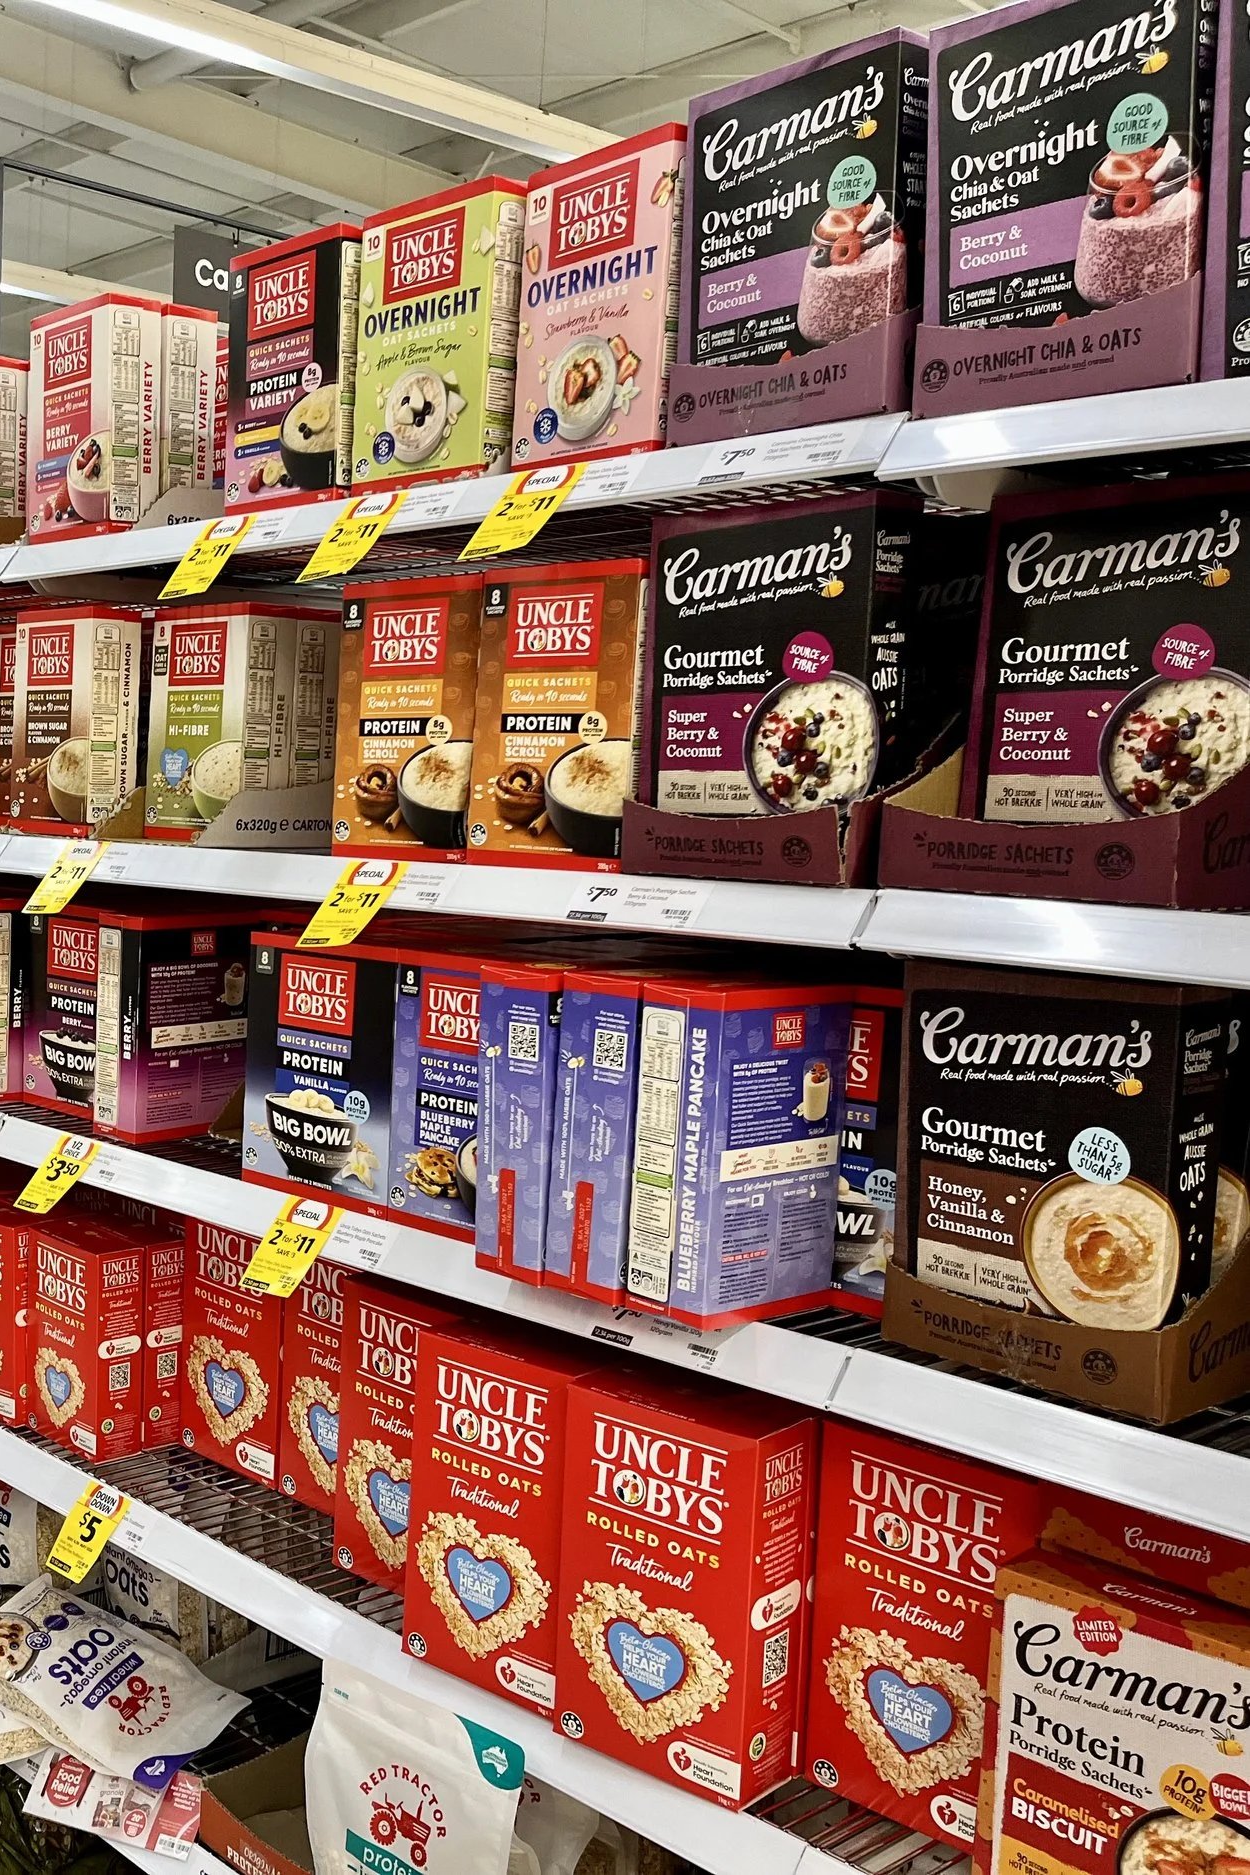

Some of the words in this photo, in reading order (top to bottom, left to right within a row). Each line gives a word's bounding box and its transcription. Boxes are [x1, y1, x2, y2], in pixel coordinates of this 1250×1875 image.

[949, 0, 1176, 122] Carman's
[970, 119, 993, 135] Real
[994, 107, 1015, 124] food
[1016, 96, 1042, 114] made
[1044, 87, 1064, 103] with
[1065, 76, 1085, 94] real
[1125, 102, 1152, 116] GOOD
[1113, 119, 1149, 133] SOURCE
[1121, 132, 1148, 146] FIBRE
[951, 119, 1098, 181] Overnight
[950, 182, 988, 203] Chia
[990, 175, 1005, 193] &
[1008, 166, 1040, 187] Oat
[950, 192, 1019, 222] Sachets
[391, 223, 456, 269] UNCLE
[390, 252, 456, 289] TOBYS
[527, 245, 658, 308] OVERNIGHT
[364, 287, 481, 339] OVERNIGHT
[547, 301, 569, 316] OAT
[573, 285, 629, 309] SACHETS
[250, 344, 272, 357] QUICK
[276, 335, 310, 351] SACHETS
[376, 350, 398, 370] Apple
[409, 342, 433, 358] Brown
[435, 341, 462, 359] Sugar
[953, 351, 1036, 377] OVERNIGHT
[1040, 342, 1075, 362] CHIA
[1080, 338, 1093, 354] &
[1098, 328, 1141, 349] OATS
[144, 361, 154, 421] VARIETY
[250, 372, 297, 395] PROTEIN
[250, 389, 296, 410] VARIETY
[143, 426, 152, 474] BERRY
[527, 475, 560, 487] SPECIAL
[496, 502, 514, 517] 2
[529, 495, 557, 512] $11
[1007, 509, 1241, 594] Carman's
[516, 598, 593, 629] UNCLE
[515, 622, 591, 654] TOBYS
[1002, 637, 1130, 664] Gourmet
[789, 644, 820, 662] SOURCE
[792, 657, 818, 674] FIBRE
[999, 668, 1065, 685] Porridge
[1069, 665, 1130, 681] Sachets
[168, 723, 210, 737] HI-FIBRE
[506, 716, 571, 730] PROTEIN
[1004, 708, 1054, 725] Super
[504, 736, 565, 746] CINNAMON
[1002, 728, 1051, 744] Berry
[1054, 728, 1068, 741] &
[505, 747, 546, 757] SCROLL
[1000, 746, 1071, 760] Coconut
[1012, 799, 1042, 807] BREKKIE
[235, 818, 278, 834] 6x320g
[293, 817, 333, 833] CARTON
[654, 836, 706, 855] PORRIDGE
[711, 838, 764, 858] SACHETS
[13, 988, 22, 1028] BERRY
[920, 1006, 1152, 1068] Carman's
[283, 1051, 343, 1077] PROTEIN
[685, 1026, 709, 1103] PANCAKE
[293, 1075, 330, 1091] VANILLA
[348, 1096, 365, 1109] 10g
[273, 1111, 301, 1137] BIG
[304, 1122, 351, 1146] BOWL
[64, 1149, 80, 1158] PRICE
[71, 1141, 83, 1151] 1/2
[273, 1137, 295, 1157] 30%
[296, 1146, 325, 1164] EXTRA
[683, 1106, 704, 1180] MAPLE
[1077, 1141, 1107, 1163] THAN
[1109, 1155, 1122, 1171] 5g
[1091, 1133, 1118, 1152] LESS
[928, 1174, 988, 1204] Honey,
[927, 1193, 987, 1221] Vanilla
[990, 1205, 1005, 1221] &
[675, 1184, 702, 1294] BLUEBERRY
[926, 1212, 1015, 1246] Cinnamon
[594, 1421, 729, 1497] UNCLE
[90, 1499, 112, 1514] DOWN
[96, 1491, 117, 1506] DOWN
[592, 1460, 728, 1535] TOBYS
[79, 1511, 102, 1542] $5
[587, 1510, 660, 1547] ROLLED
[668, 1541, 721, 1569] OATS
[606, 1543, 693, 1593] Traditional
[1076, 1620, 1115, 1634] LIMITED
[1080, 1630, 1118, 1644] EDITION
[49, 1629, 114, 1685] oats
[622, 1652, 666, 1677] HEART
[110, 1659, 138, 1686] wheat
[90, 1684, 111, 1703] free
[159, 1686, 170, 1708] RED
[119, 1712, 169, 1736] TRACTOR
[1009, 1692, 1145, 1777] Protein
[56, 1769, 82, 1784] Food
[693, 1763, 713, 1777] Heart
[1009, 1730, 1077, 1772] Porridge
[1080, 1767, 1145, 1800] Sachets
[51, 1781, 80, 1797] Relief
[693, 1771, 734, 1793] Foundation
[1174, 1770, 1207, 1804] 10g
[359, 1768, 388, 1795] RED
[391, 1764, 447, 1838] TRACTOR
[1013, 1778, 1120, 1839] Caramelised
[1164, 1785, 1201, 1813] PROTEIN
[1011, 1798, 1108, 1855] BISCUIT
